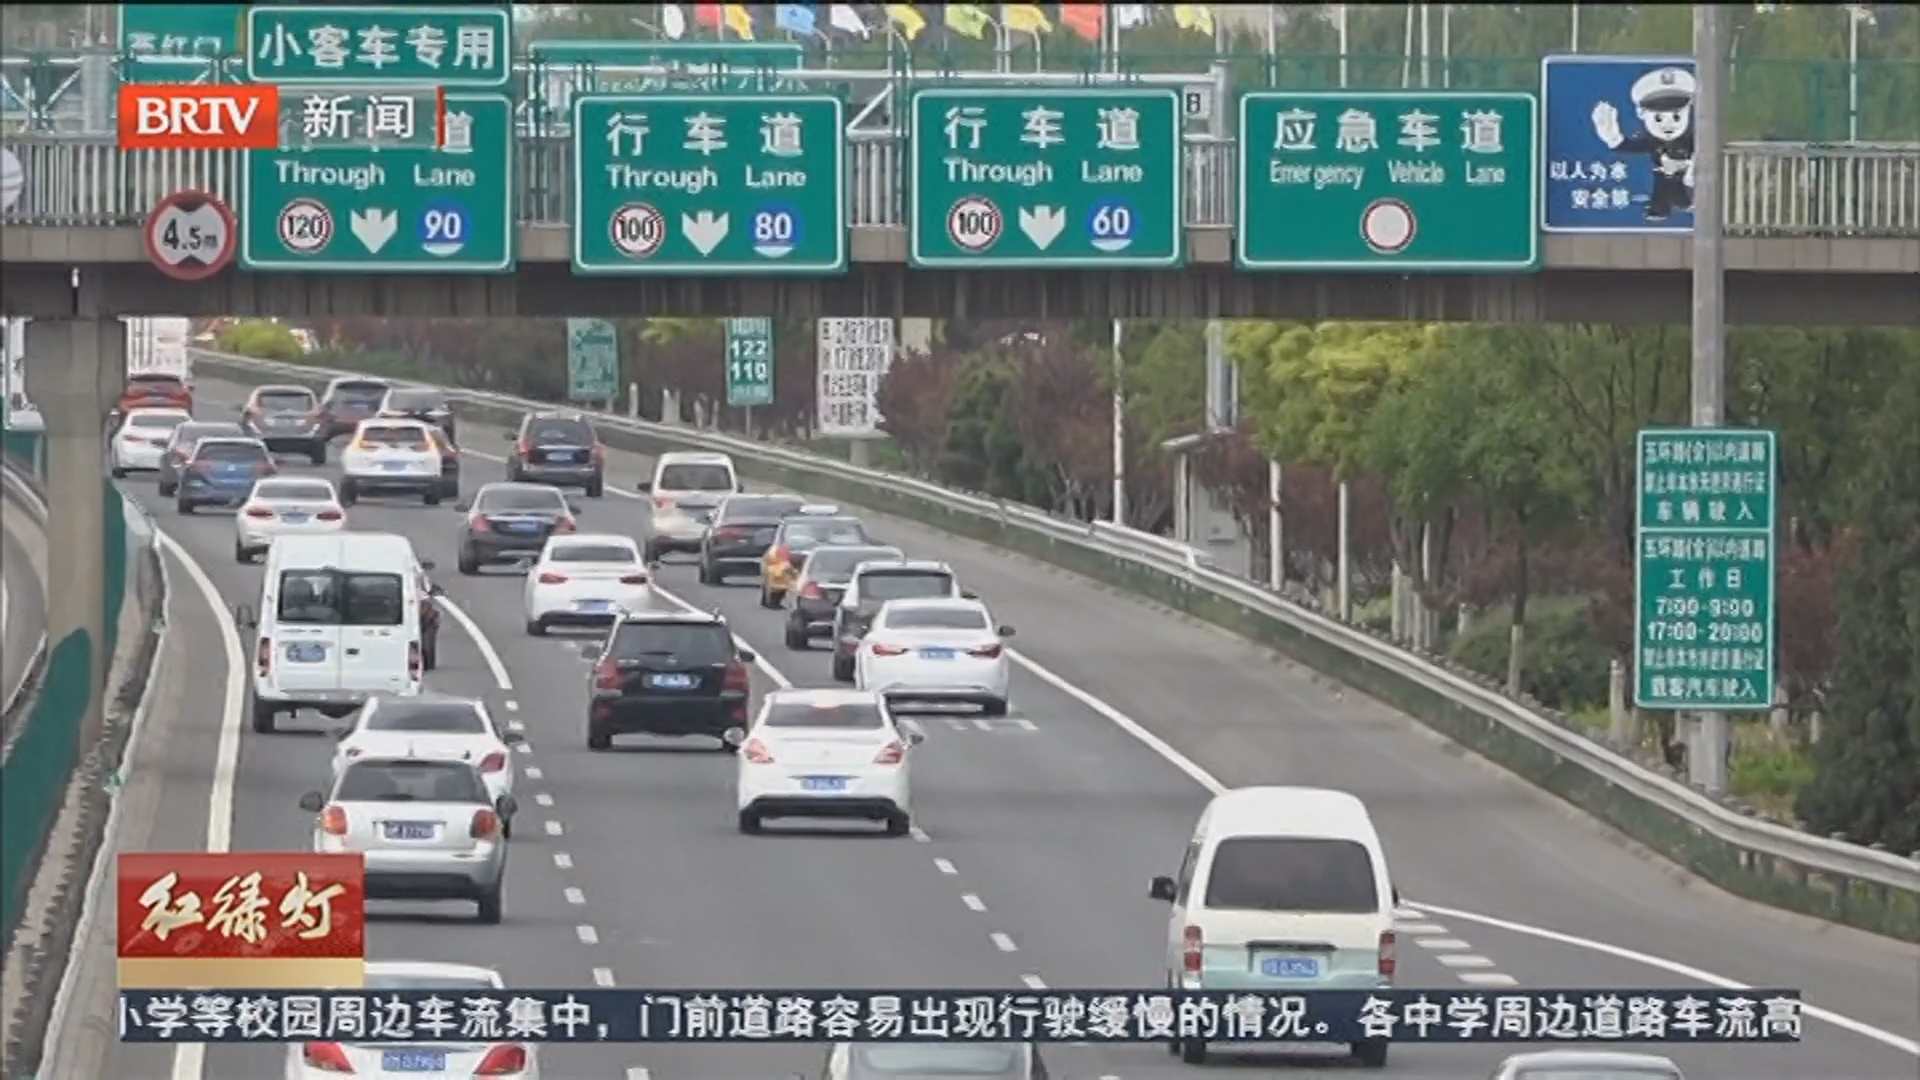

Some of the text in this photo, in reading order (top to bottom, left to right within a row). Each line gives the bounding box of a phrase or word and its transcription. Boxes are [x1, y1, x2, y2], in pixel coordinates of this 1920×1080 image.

[259, 23, 495, 69] 小客车专用
[606, 111, 805, 158] 行车道
[943, 105, 1141, 150] 行车道
[1273, 108, 1505, 153] 应急车道
[274, 159, 476, 190] Through Lane
[605, 164, 807, 194] Through Lane
[943, 156, 1144, 187] Through Lane
[1269, 159, 1506, 190] Emergency Vehicle Lane
[287, 215, 324, 240] 120
[424, 209, 462, 240] 90
[618, 216, 655, 242] 100
[755, 212, 794, 240] 80
[957, 212, 994, 236] 100
[1092, 206, 1132, 236] 60
[1668, 567, 1743, 590] 工作日
